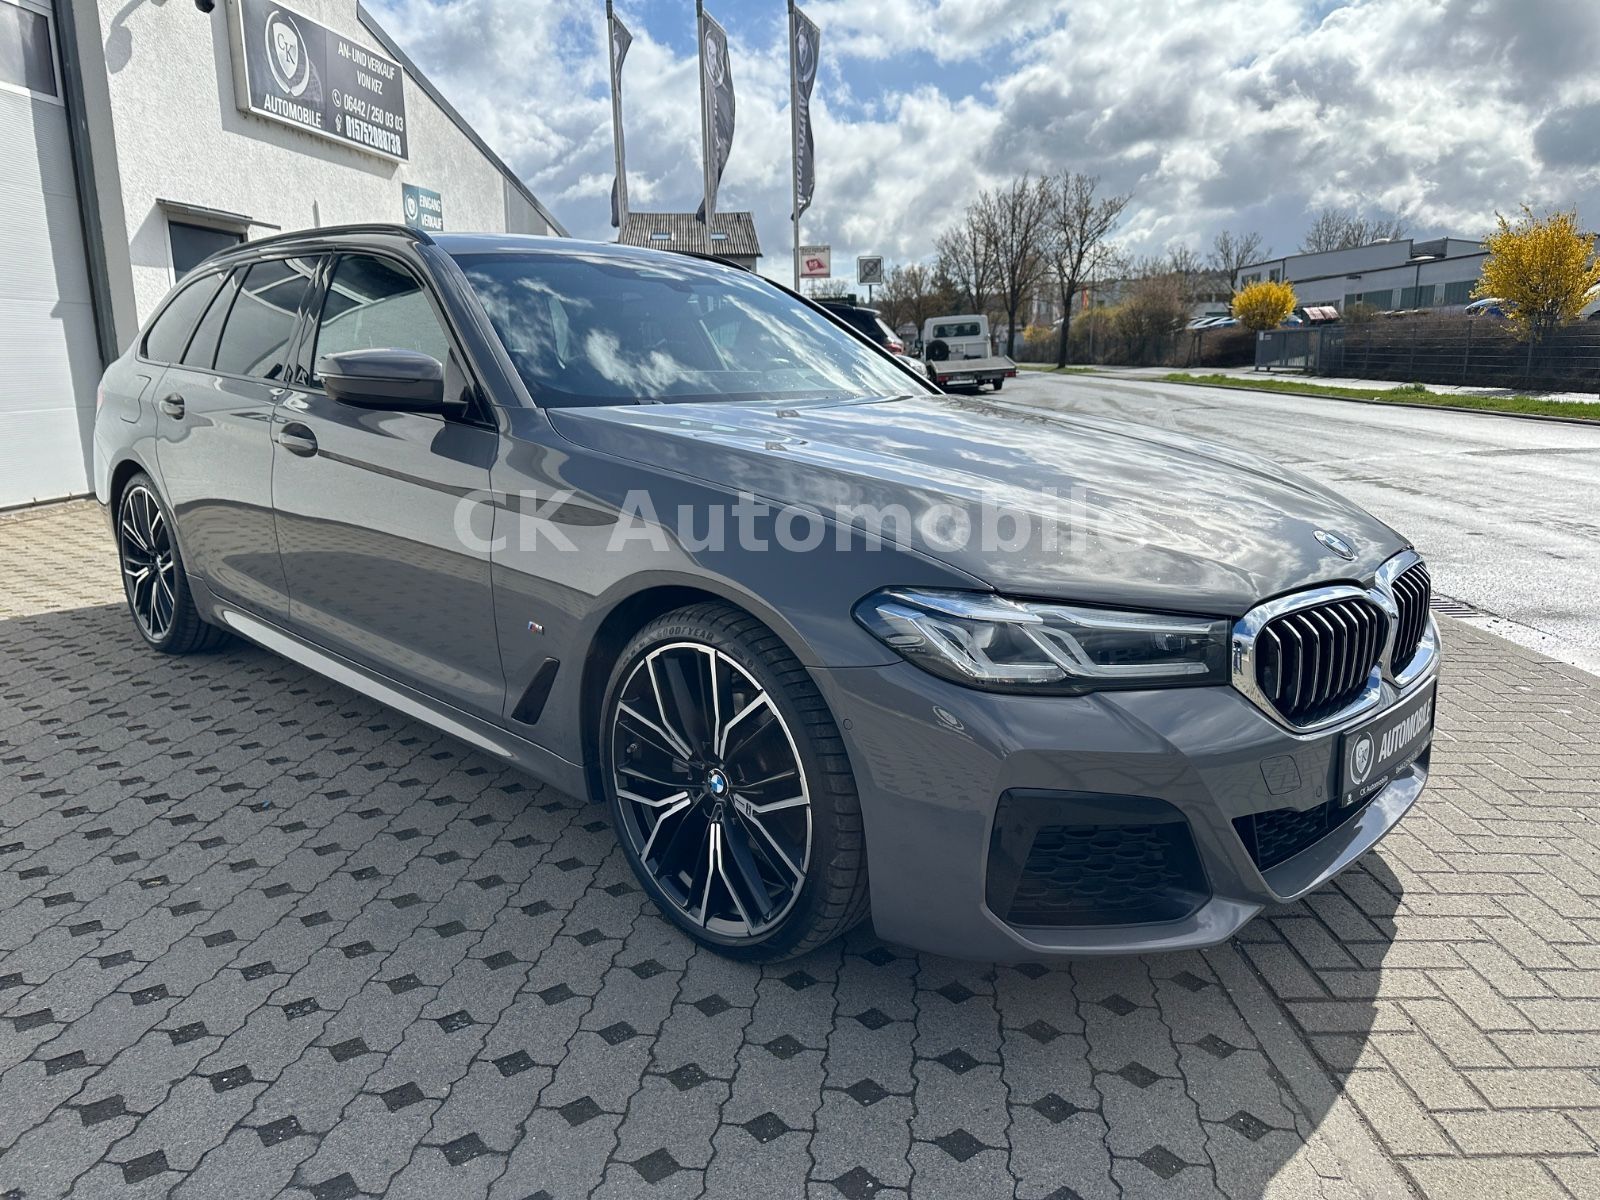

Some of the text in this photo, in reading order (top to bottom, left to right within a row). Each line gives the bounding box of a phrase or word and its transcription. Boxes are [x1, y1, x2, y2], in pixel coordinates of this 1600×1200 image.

[352, 47, 367, 67] UND
[367, 55, 395, 81] VERKAUF
[356, 70, 383, 95] VON KFZ
[263, 93, 322, 129] AUTOMOBILE
[343, 93, 366, 118] 06442
[371, 105, 384, 125] 250
[385, 111, 394, 129] 03
[394, 114, 404, 132] 03
[1378, 697, 1432, 763] AUTOMOBILE
